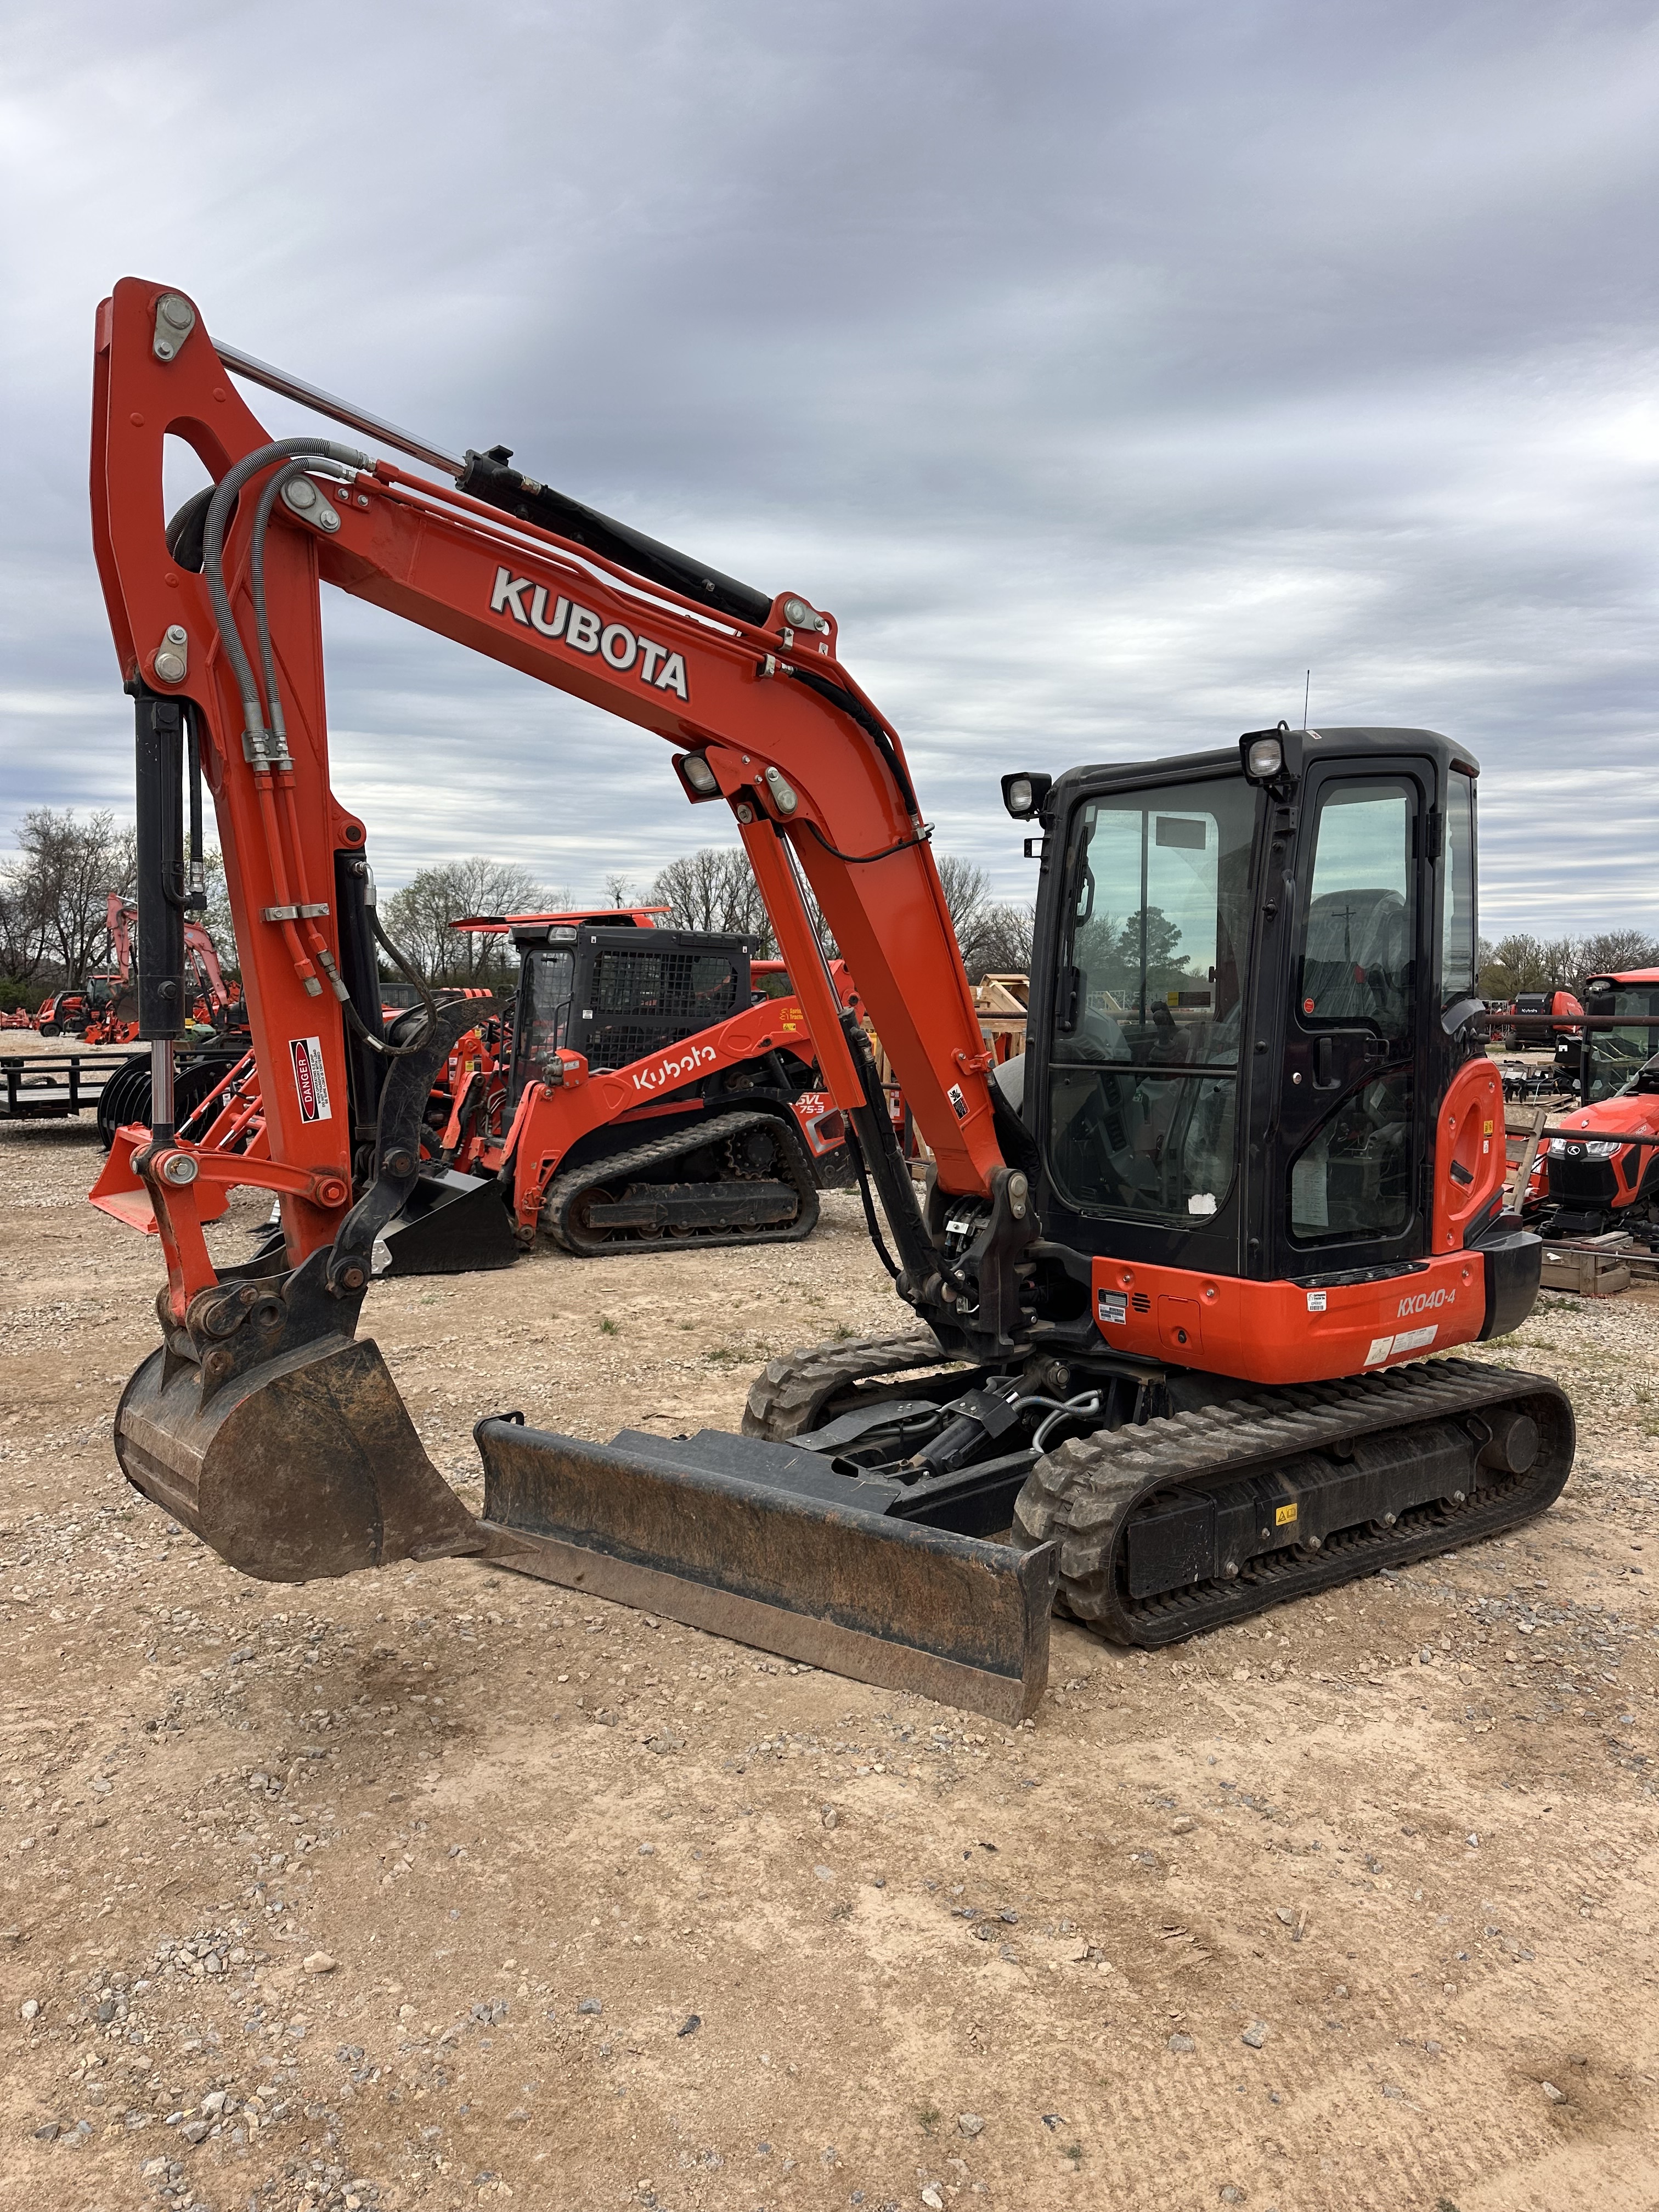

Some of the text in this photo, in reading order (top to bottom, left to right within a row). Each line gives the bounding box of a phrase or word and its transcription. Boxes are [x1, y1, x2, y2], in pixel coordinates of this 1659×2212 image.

[490, 566, 687, 701] KUBOTA
[298, 1059, 313, 1103] DANGER
[633, 1046, 716, 1090] Kubota
[798, 1094, 823, 1104] SVL
[800, 1105, 825, 1114] 75-3
[1397, 1288, 1456, 1318] KX040-4
